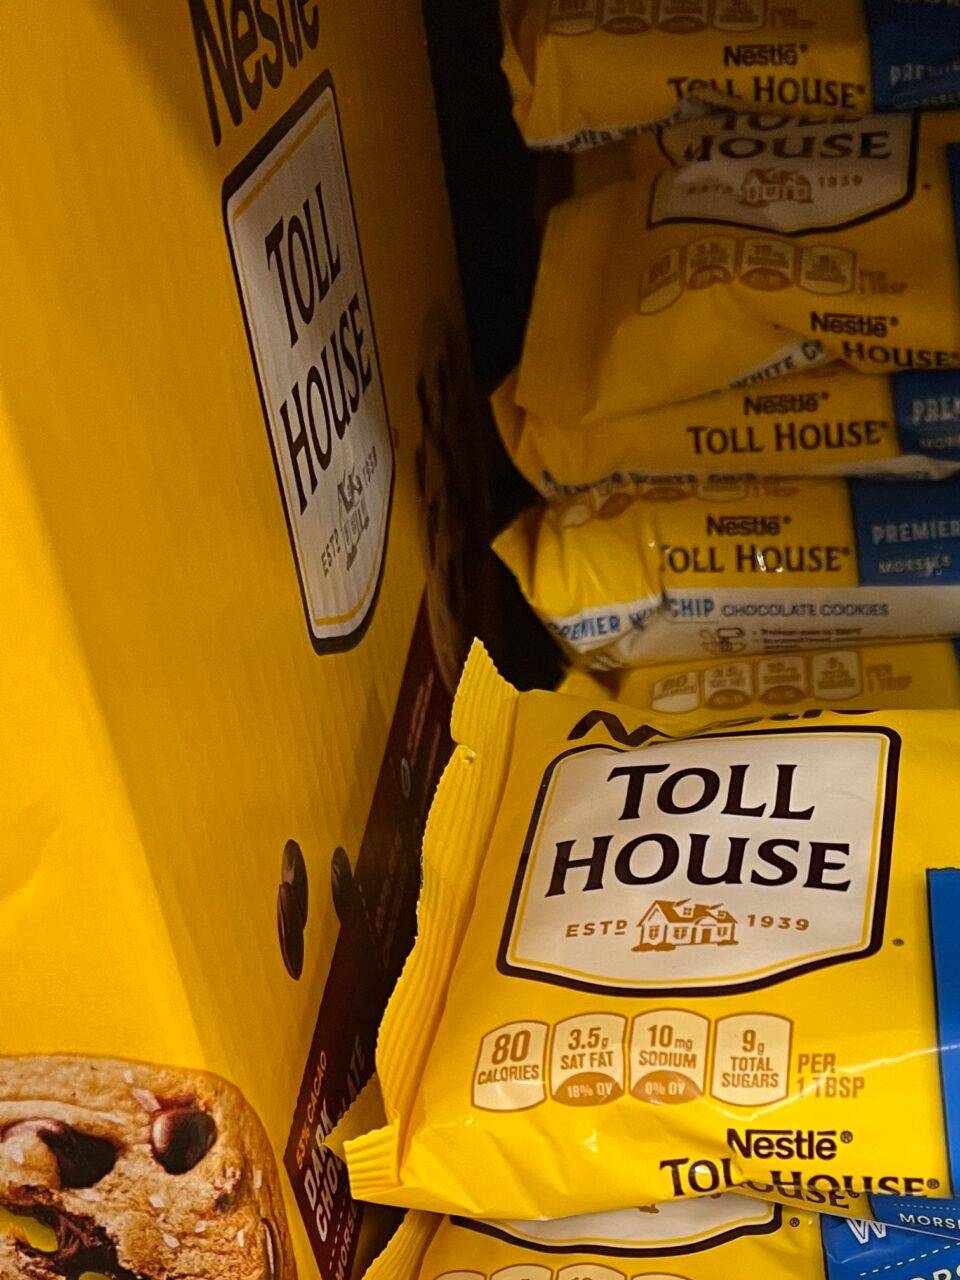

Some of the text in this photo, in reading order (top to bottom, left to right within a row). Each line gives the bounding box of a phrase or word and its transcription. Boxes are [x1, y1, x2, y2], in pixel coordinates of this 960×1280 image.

[264, 182, 340, 349] TOLL
[279, 291, 372, 515] HOUSE
[687, 426, 764, 454] TOLL
[659, 544, 724, 574] TOLL
[721, 603, 888, 617] CHOCOLATE COOKIES
[607, 764, 815, 821] TOLL
[545, 833, 851, 899] HOUSE
[748, 915, 809, 931] 1939
[491, 1029, 530, 1064] 80
[561, 1051, 613, 1069] SAT FAT
[639, 1051, 697, 1069] SODIUM
[477, 1065, 540, 1084] CALORIES
[730, 1056, 773, 1072] TOTAL
[797, 1054, 836, 1072] PER
[307, 1051, 327, 1123] CACAO
[721, 1072, 779, 1088] SUGARS
[304, 1099, 334, 1210] DARK
